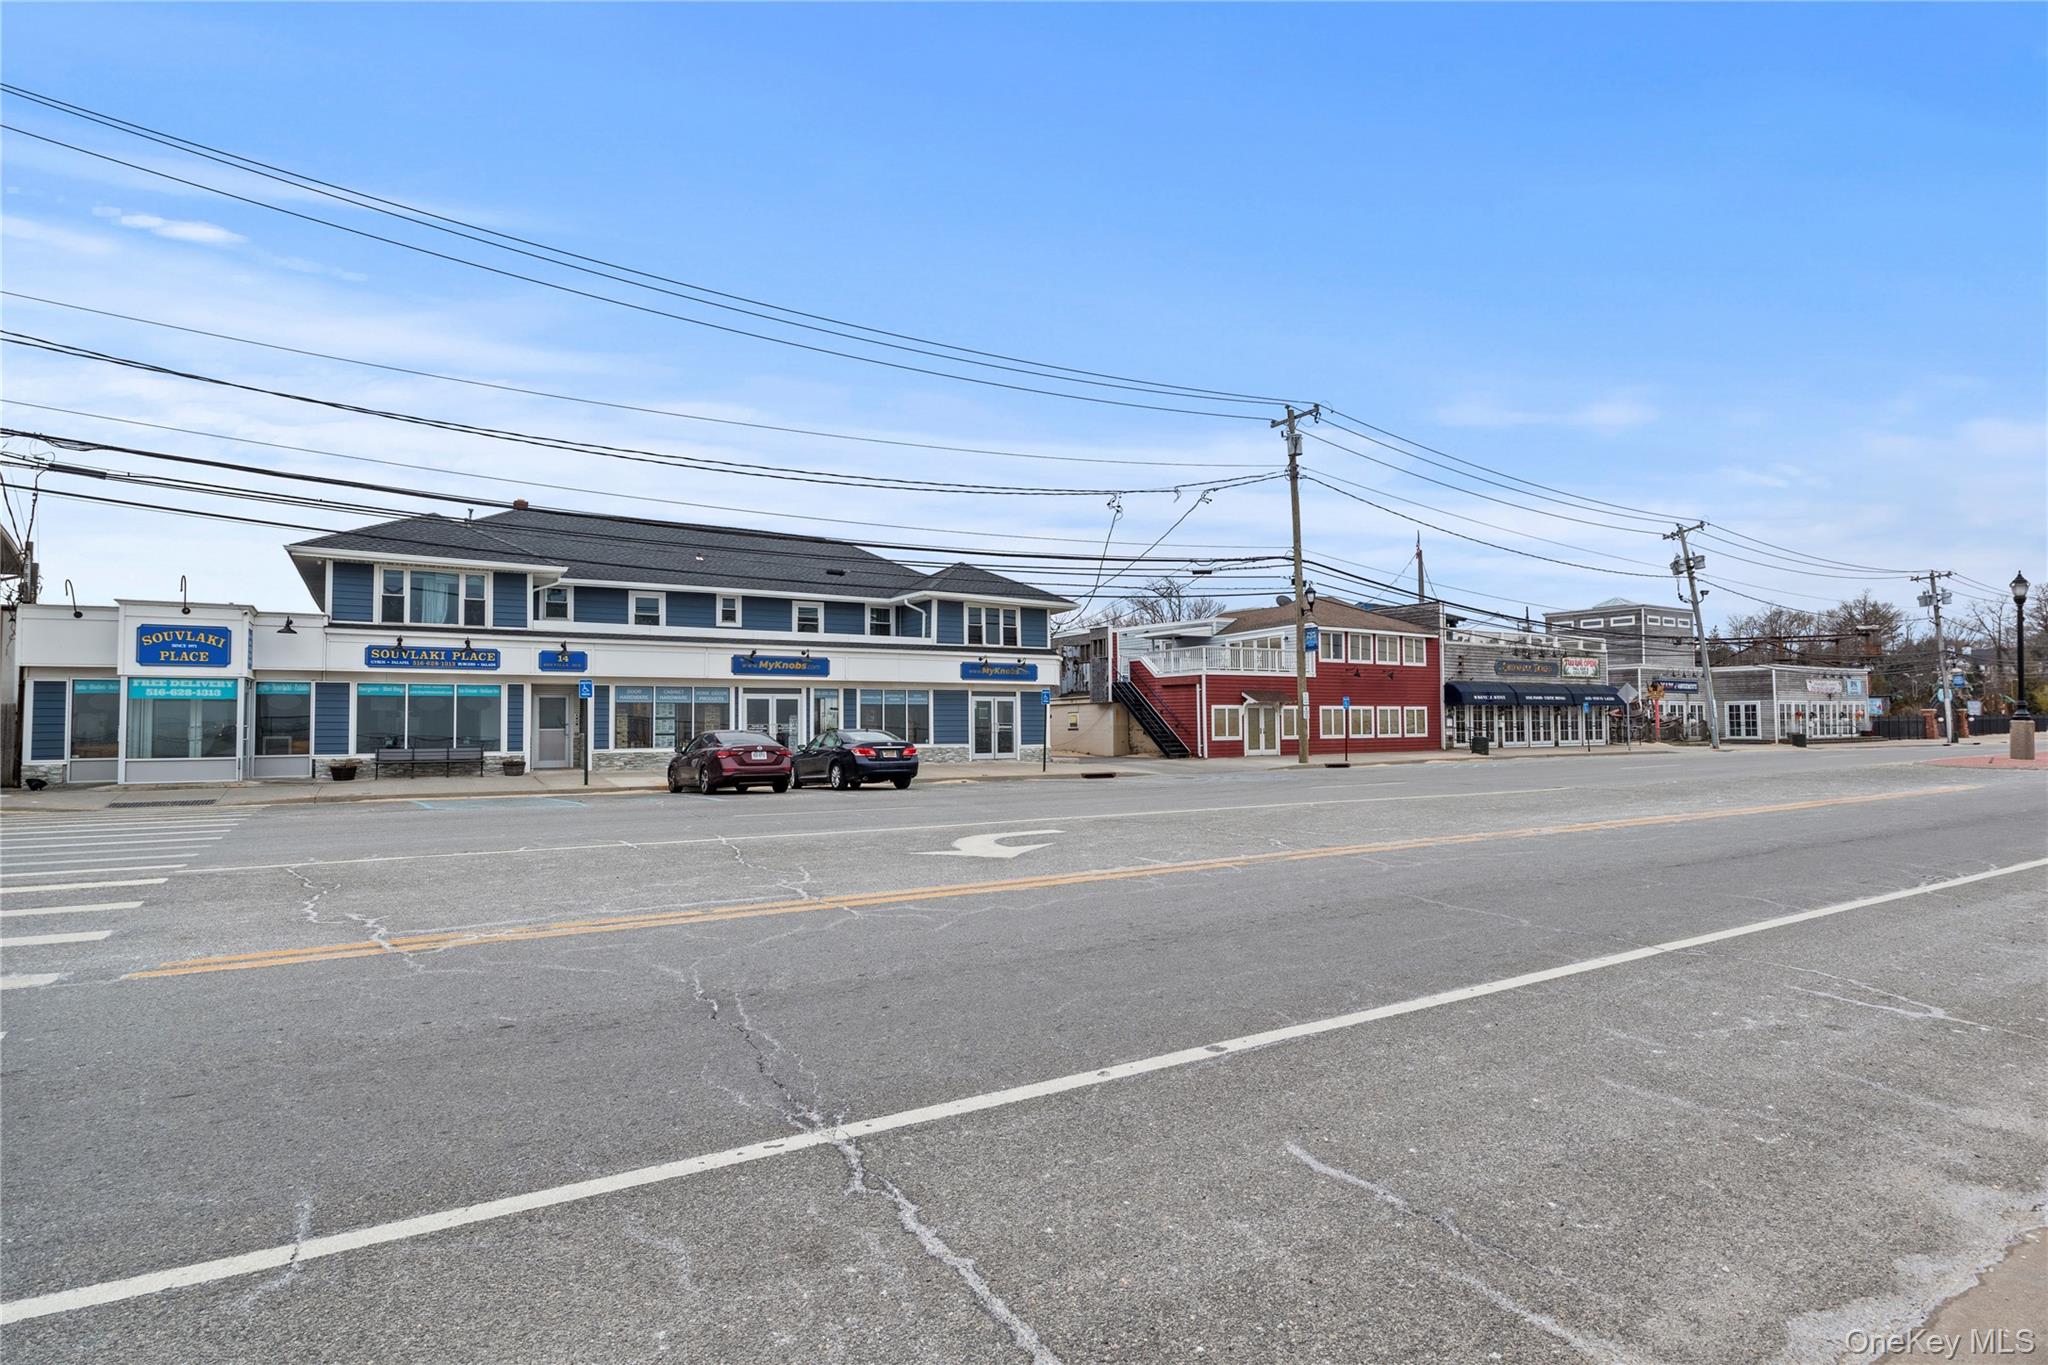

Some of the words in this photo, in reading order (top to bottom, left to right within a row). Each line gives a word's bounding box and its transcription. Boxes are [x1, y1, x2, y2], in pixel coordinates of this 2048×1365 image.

[142, 630, 226, 648] SOUVLAKI
[160, 650, 209, 662] PLACE
[371, 648, 446, 660] SOUVLAKI
[452, 651, 496, 662] PLACE
[133, 679, 167, 687] FREE
[170, 680, 234, 689] DELIVERY
[145, 688, 222, 697] 516-628-1313
